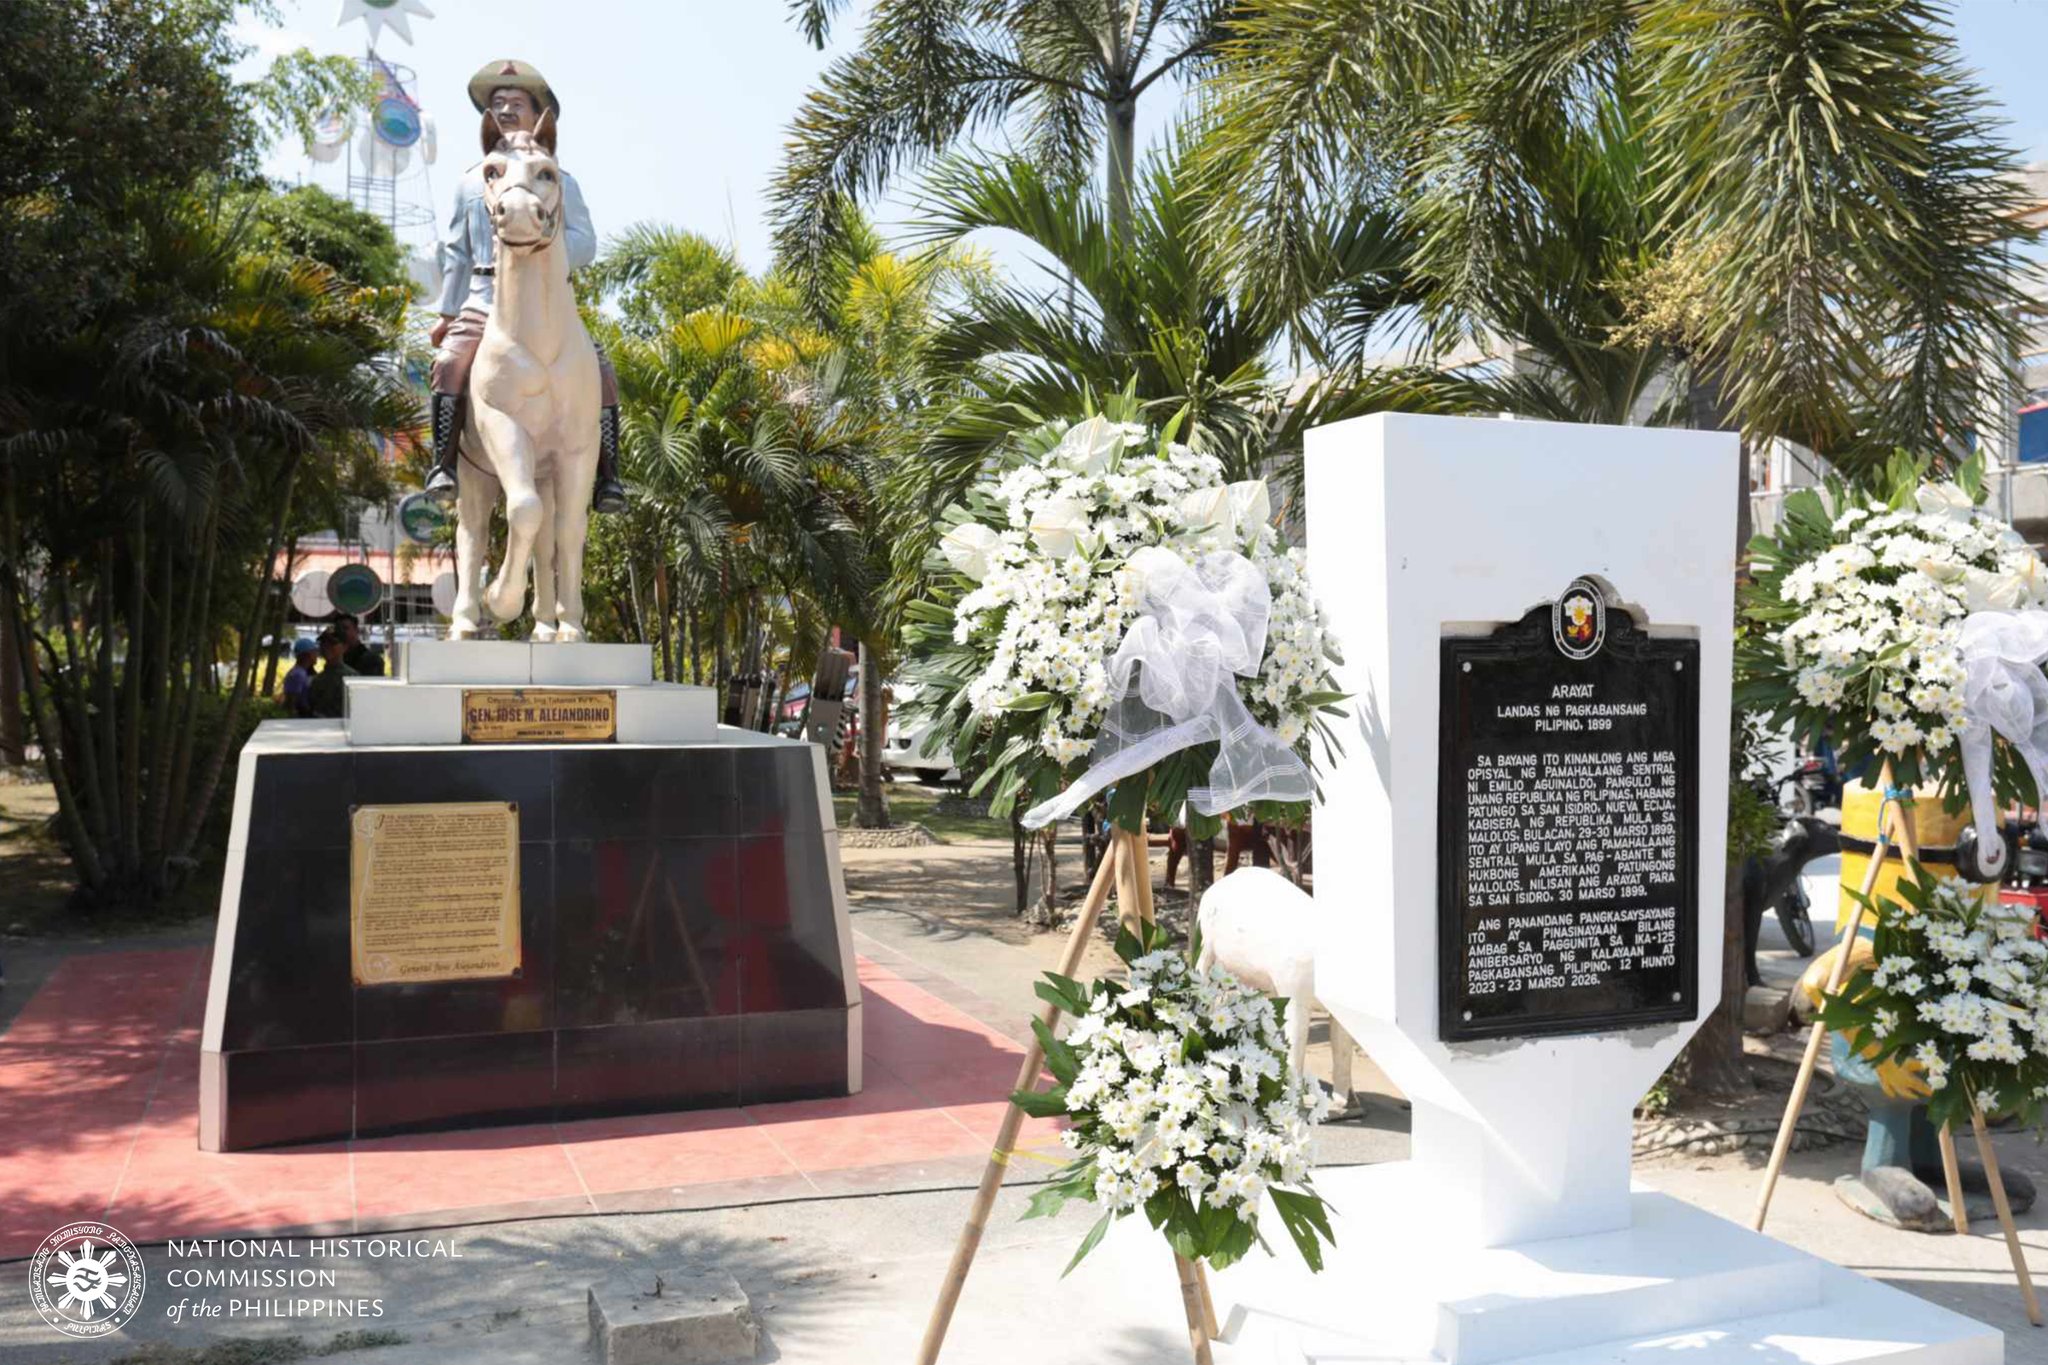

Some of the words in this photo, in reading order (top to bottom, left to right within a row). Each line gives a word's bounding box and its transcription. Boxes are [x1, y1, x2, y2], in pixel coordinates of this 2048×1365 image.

[1552, 684, 1594, 699] ARAYAT
[539, 707, 610, 722] ALEJANDRINO
[1498, 706, 1540, 717] LANDAS
[1546, 705, 1560, 716] NG
[1566, 704, 1647, 716] PAGKABANSANG
[1536, 720, 1583, 732] PILIPINO,
[1588, 719, 1612, 730] 1899
[1478, 756, 1491, 767] SA
[1498, 754, 1537, 766] BAYANG
[1543, 754, 1559, 765] ITO
[1565, 753, 1622, 765] KINANLONG
[1627, 752, 1647, 763] ANG
[1654, 751, 1675, 762] MGA
[1468, 768, 1512, 780] OPISYAL
[1521, 768, 1536, 778] NG
[1545, 765, 1623, 778] PAMAHALAANG
[1633, 763, 1675, 775] SENTRAL
[1468, 781, 1478, 792] NI
[1489, 780, 1524, 792] EMILIO
[1534, 778, 1596, 790] AGUINALDO,
[1606, 777, 1651, 788] PANGULO
[1662, 776, 1675, 786] NG
[1468, 793, 1503, 805] UNANG
[1506, 790, 1563, 804] REPUBLIKA
[1566, 791, 1581, 801] NG
[1584, 789, 1633, 801] PILIPINAS,
[1636, 788, 1675, 799] HABANG
[1468, 805, 1516, 817] PATUNGO
[1521, 804, 1535, 816] SA
[1540, 804, 1559, 815] SAN
[1565, 802, 1601, 814] ISIDRO,
[1606, 801, 1638, 813] NUEVA
[1644, 799, 1675, 811] ECIJA,
[1469, 817, 1520, 830] KABISERA
[1530, 816, 1545, 827] NG
[1555, 814, 1612, 827] REPUBLIKA
[1624, 814, 1652, 824] MULA
[1662, 812, 1675, 823] SA
[1469, 830, 1519, 843] MALOLOS,
[1524, 828, 1575, 841] BULACAN,
[1579, 827, 1609, 838] 29-30
[1614, 825, 1648, 836] MARSO
[1651, 824, 1675, 835] 1899.
[1469, 844, 1484, 856] ITO
[1489, 843, 1501, 854] AY
[1507, 842, 1539, 853] UPANG
[1545, 840, 1572, 852] ILAYO
[1576, 839, 1597, 850] ANG
[1602, 836, 1675, 849] PAMAHALAANG
[1469, 856, 1518, 868] SENTRAL
[1526, 854, 1556, 866] MULA
[1564, 853, 1577, 863] SA
[1662, 848, 1675, 858] NG
[1469, 868, 1519, 881] HUKBONG
[1539, 864, 1600, 877] AMERIKANO
[1618, 860, 1675, 873] PATUNGONG
[1469, 881, 1523, 894] MALOLOS.
[1530, 878, 1572, 890] NILISAN
[1579, 876, 1600, 887] ANG
[1606, 874, 1641, 886] ARAYAT
[1649, 872, 1675, 883] PARA
[1469, 895, 1483, 907] SA
[1489, 893, 1509, 905] SAN
[1516, 891, 1554, 904] ISIDRO,
[1559, 890, 1573, 901] 30
[1579, 888, 1615, 900] MARSO
[1621, 886, 1647, 898] 1899.
[1478, 919, 1501, 931] ANG
[1509, 913, 1573, 929] PANANDANG
[1580, 907, 1675, 923] PANGKASAYSAYANG
[1468, 932, 1485, 944] ITO
[1508, 930, 1521, 941] AY
[1543, 924, 1617, 939] PINASINAYAAN
[1638, 920, 1675, 933] BILANG
[1469, 943, 1507, 957] AMBAG
[1518, 942, 1532, 953] SA
[1543, 937, 1600, 952] PAGGUNITA
[1610, 936, 1623, 946] SA
[1635, 932, 1675, 944] IKA-125
[1469, 954, 1543, 969] ANIBERSARYO
[1560, 951, 1575, 962] NG
[1592, 946, 1644, 960] KALAYAAN
[1662, 943, 1675, 954] AT
[1469, 964, 1554, 982] PAGKABANSANG
[1564, 961, 1611, 974] PILIPINO,
[1620, 959, 1631, 970] 12
[1642, 955, 1675, 968] HUNYO
[1528, 976, 1565, 989] MARSO
[1572, 974, 1600, 986] 2026.
